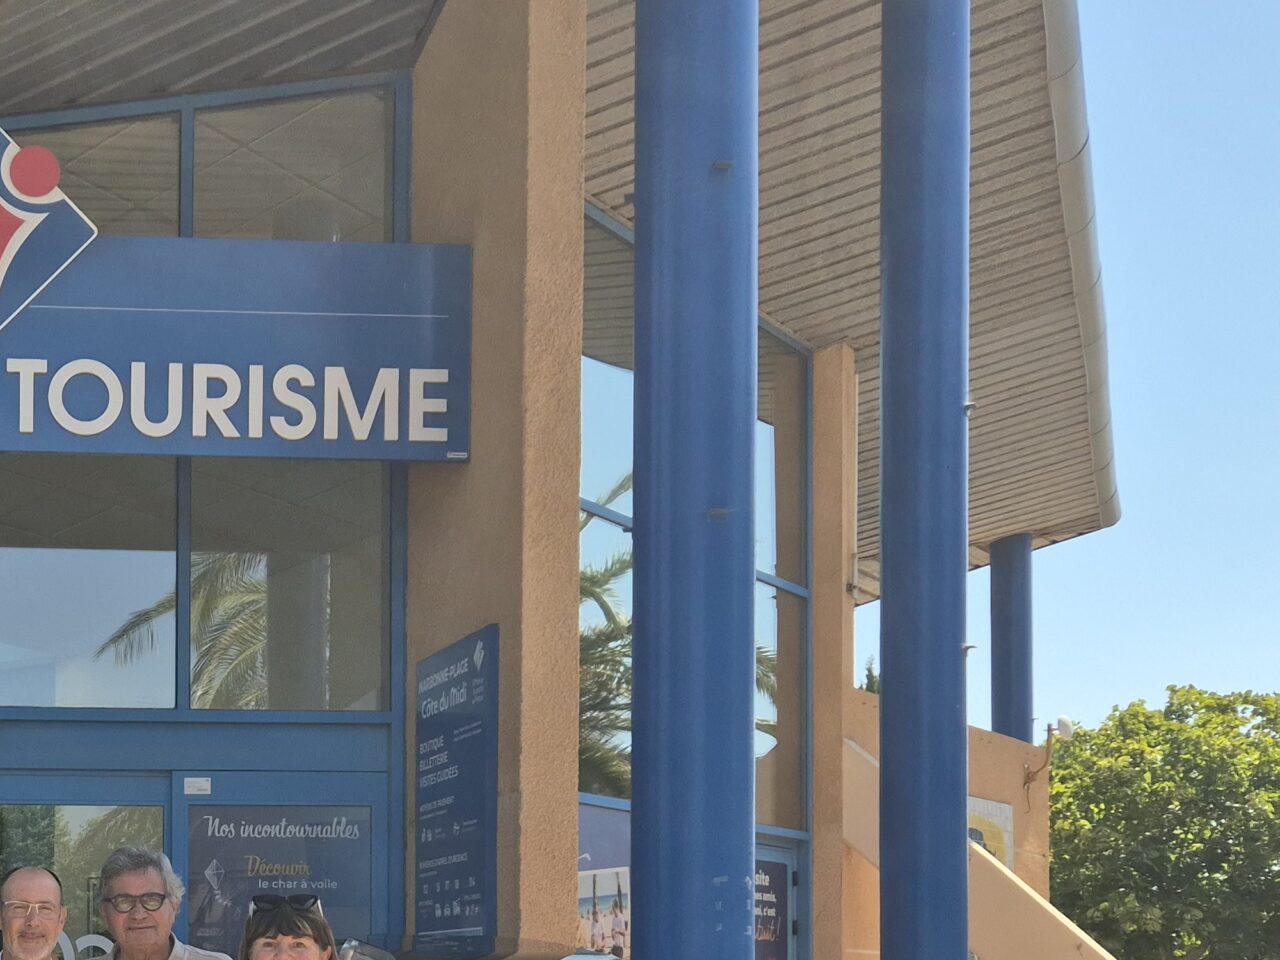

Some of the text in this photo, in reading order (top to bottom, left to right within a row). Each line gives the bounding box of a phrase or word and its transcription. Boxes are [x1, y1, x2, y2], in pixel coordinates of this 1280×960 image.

[5, 357, 450, 443] TOURISME
[421, 698, 439, 719] Côte
[439, 691, 449, 712] du
[449, 681, 468, 708] Midi
[203, 815, 360, 839] Nos incontournables
[258, 878, 338, 889] le char à voile
